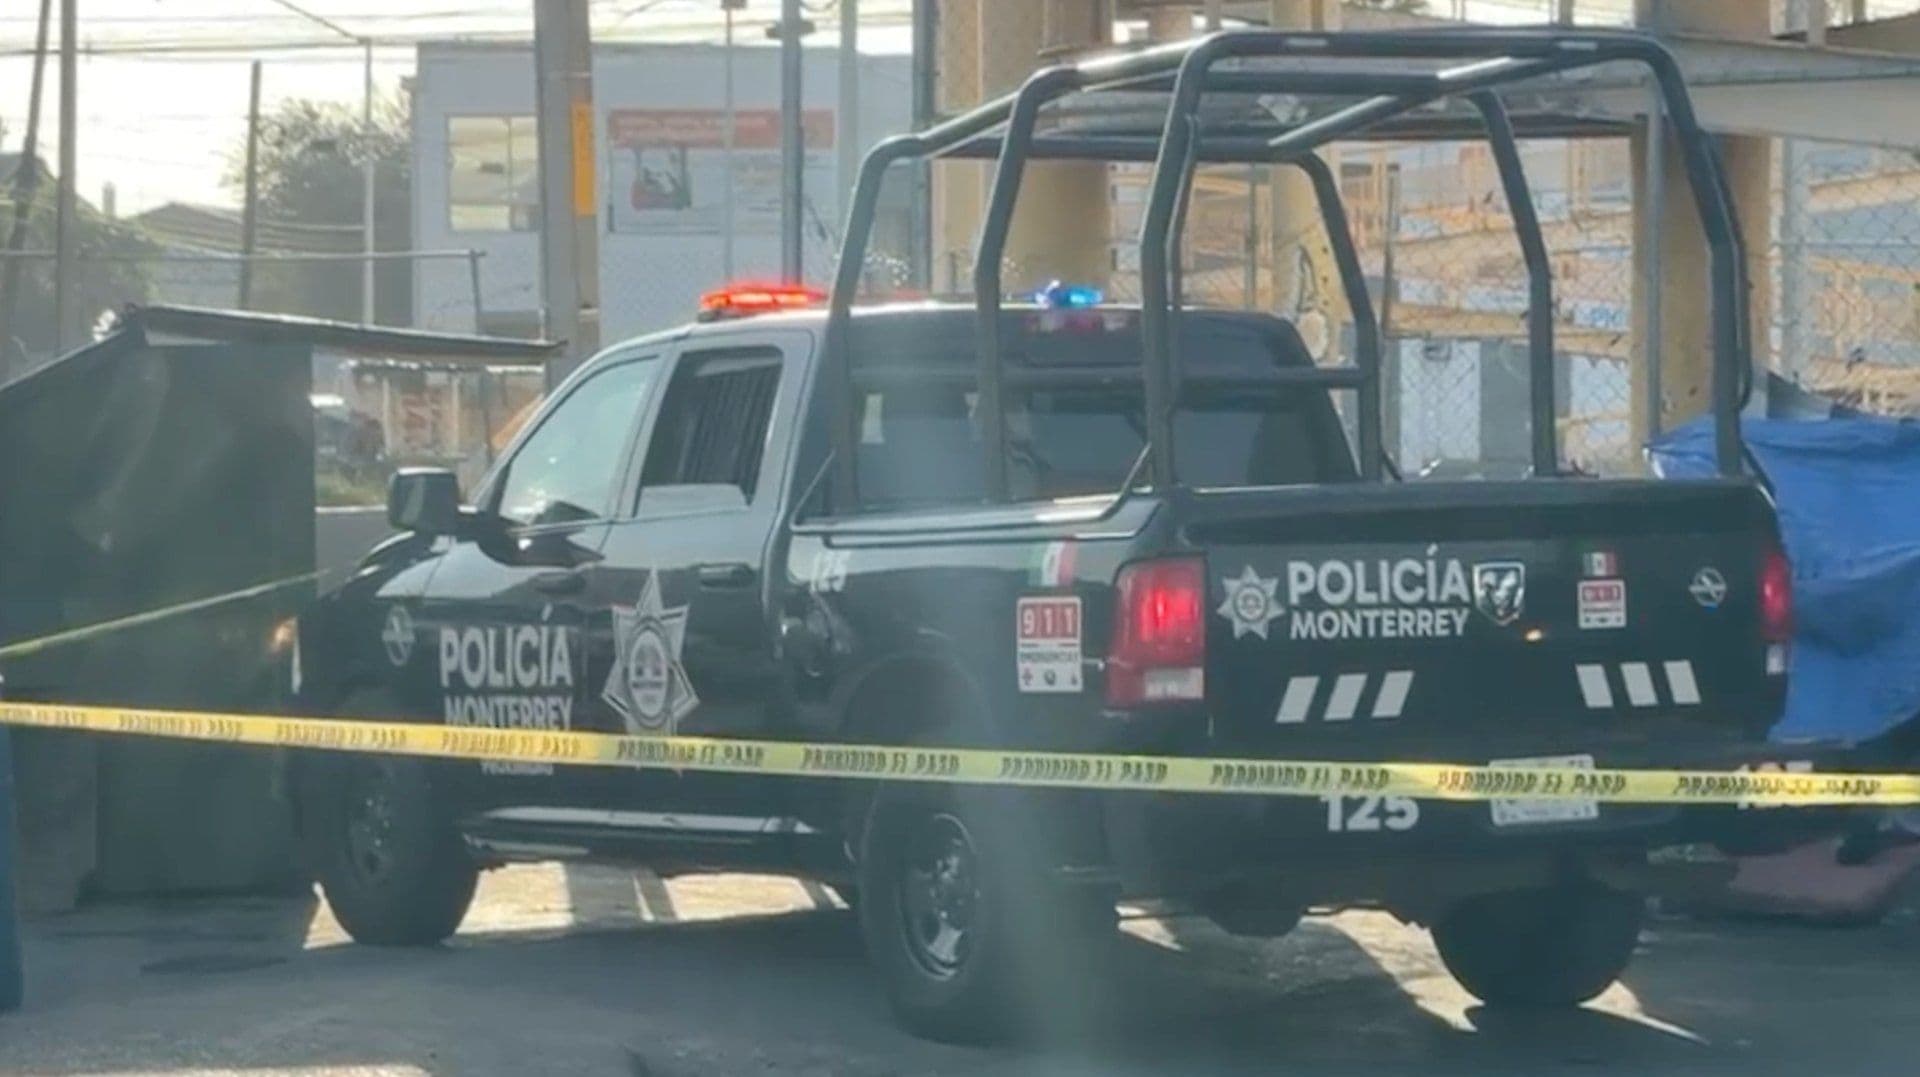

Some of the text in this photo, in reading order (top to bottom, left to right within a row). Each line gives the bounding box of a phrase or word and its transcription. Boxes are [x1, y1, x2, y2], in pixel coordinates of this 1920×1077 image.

[1288, 544, 1470, 605] POLICÍA
[1023, 607, 1074, 635] 911
[1290, 608, 1470, 640] MONTERREY
[440, 603, 574, 689] POLICÍA
[444, 695, 574, 731] MONTERREY
[1320, 793, 1420, 832] 125
